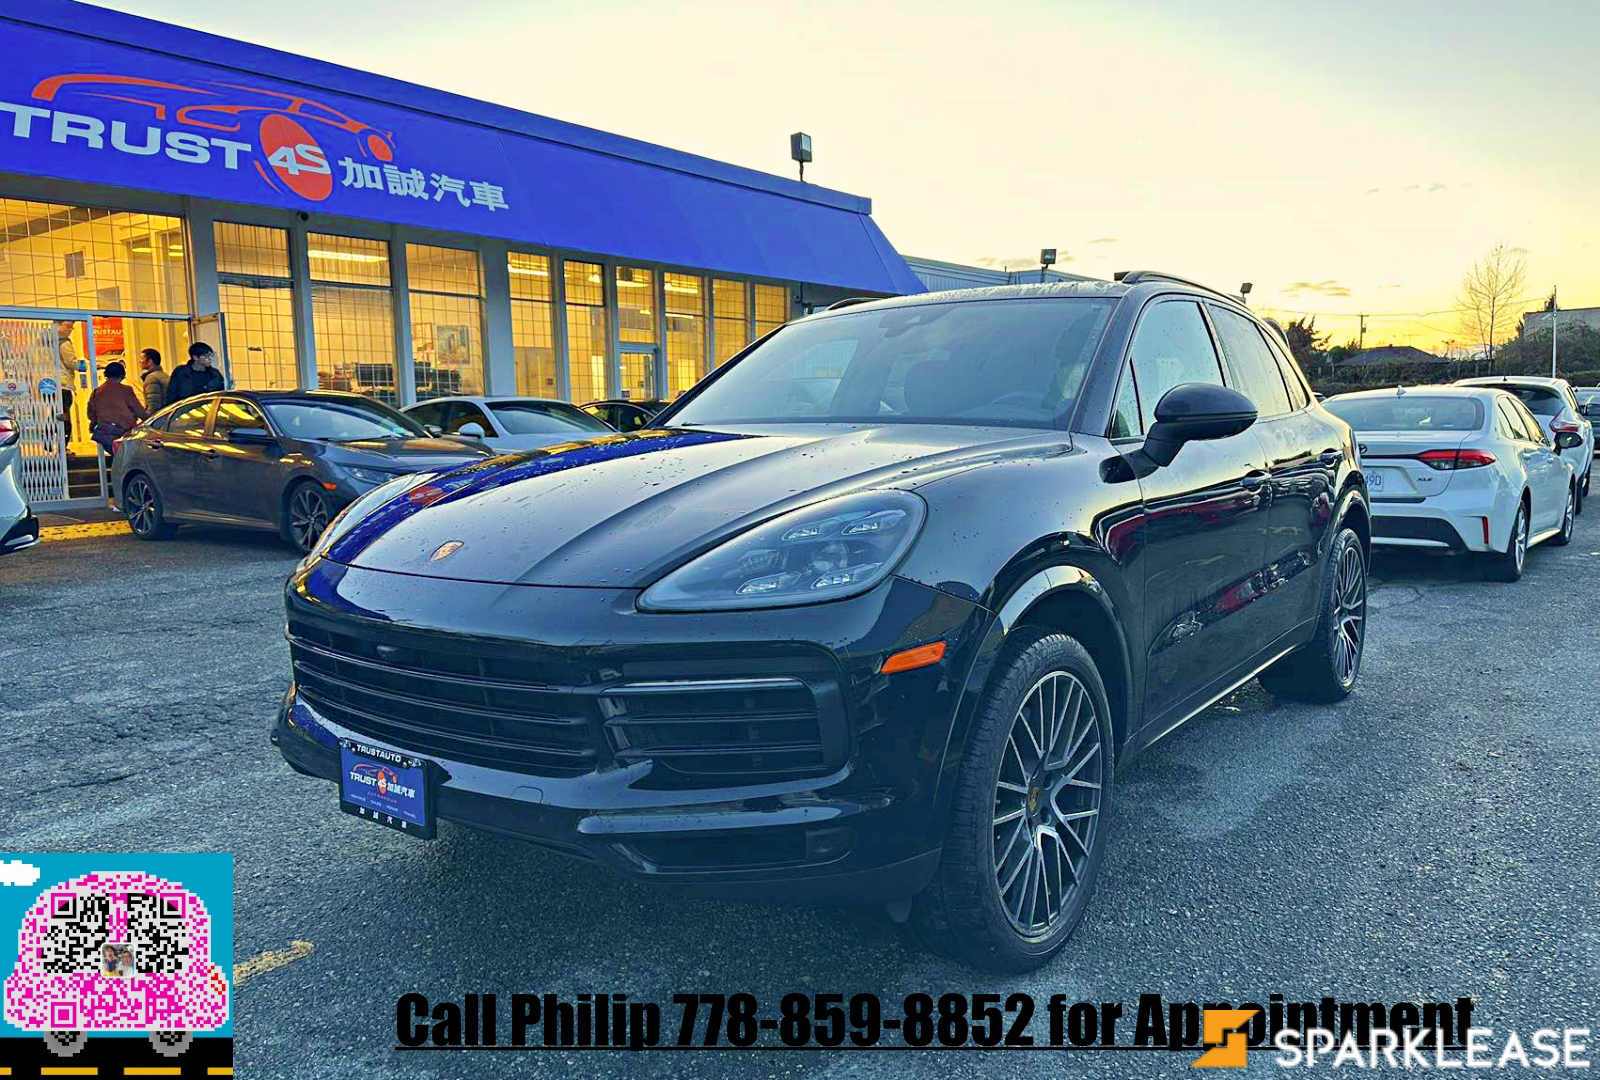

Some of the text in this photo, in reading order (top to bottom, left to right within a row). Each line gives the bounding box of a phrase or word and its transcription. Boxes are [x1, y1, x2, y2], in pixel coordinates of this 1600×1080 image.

[0, 101, 331, 176] TRUST 4S
[338, 157, 509, 212] 加誠汽車
[356, 744, 402, 763] TRUSTAUTO
[350, 771, 377, 786] TRUST
